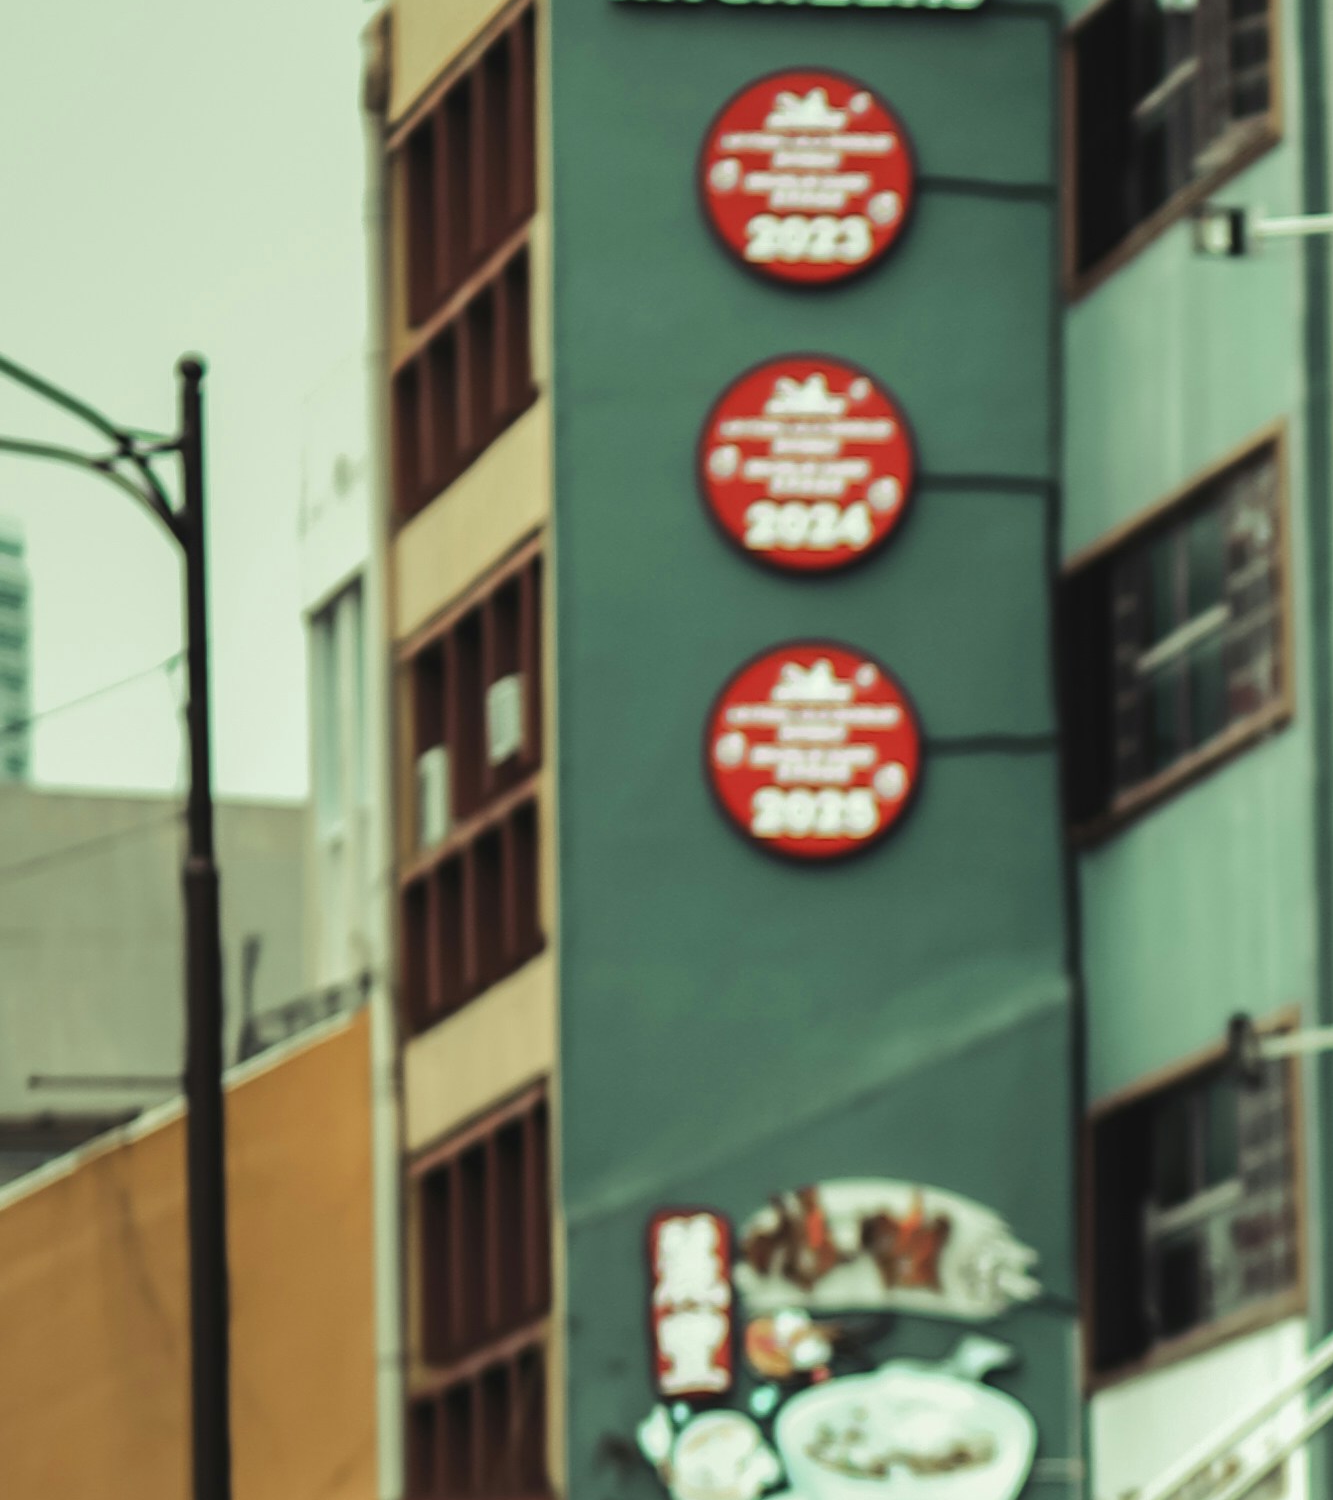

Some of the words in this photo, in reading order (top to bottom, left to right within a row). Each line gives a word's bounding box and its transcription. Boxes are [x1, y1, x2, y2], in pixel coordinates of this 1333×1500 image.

[744, 213, 874, 264] 2023
[744, 500, 873, 551] 2024
[751, 786, 879, 838] 2025
